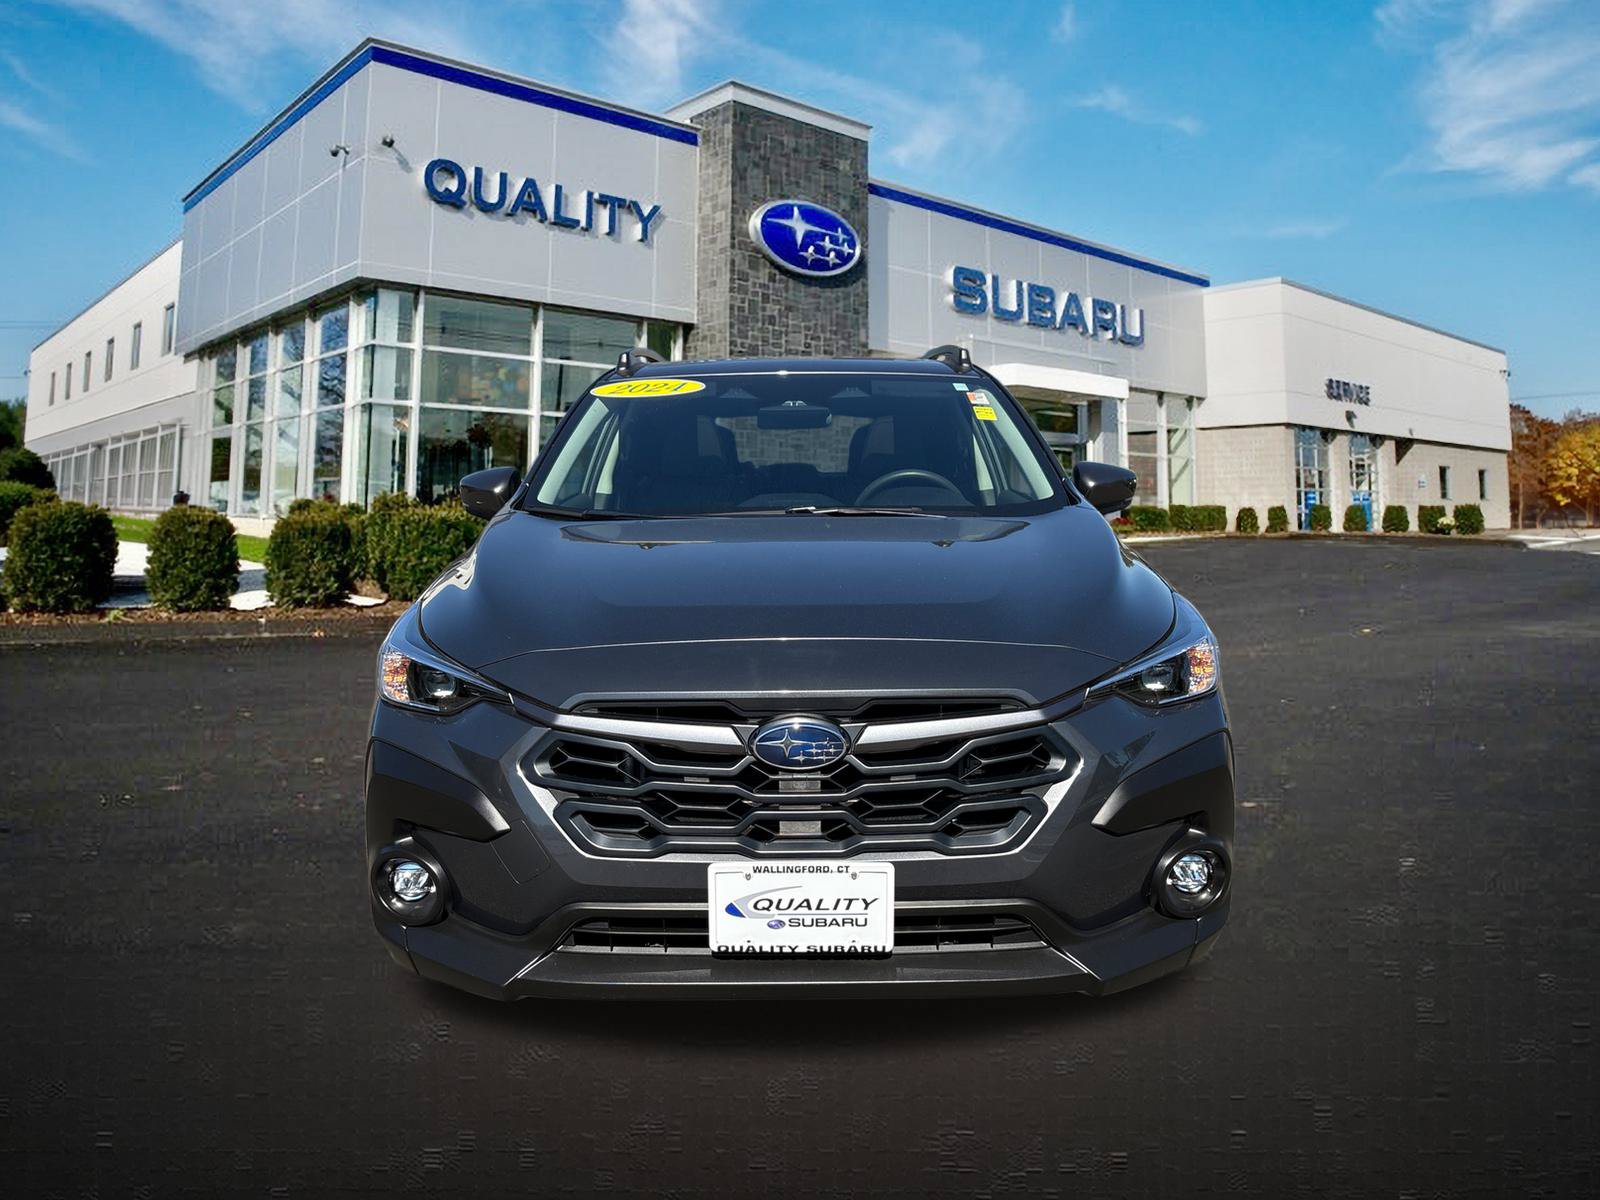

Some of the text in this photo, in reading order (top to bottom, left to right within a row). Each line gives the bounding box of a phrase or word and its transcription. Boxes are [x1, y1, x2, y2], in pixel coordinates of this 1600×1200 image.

[424, 158, 662, 242] QUALITY
[952, 265, 1145, 346] SUBARU
[608, 382, 688, 395] 2024
[1325, 378, 1371, 406] SERVICE
[752, 865, 850, 874] WALLINGFORD, CT
[752, 898, 880, 912] QUALITY
[788, 917, 868, 927] SUBARU
[717, 945, 887, 953] QUALITY SUBARU
